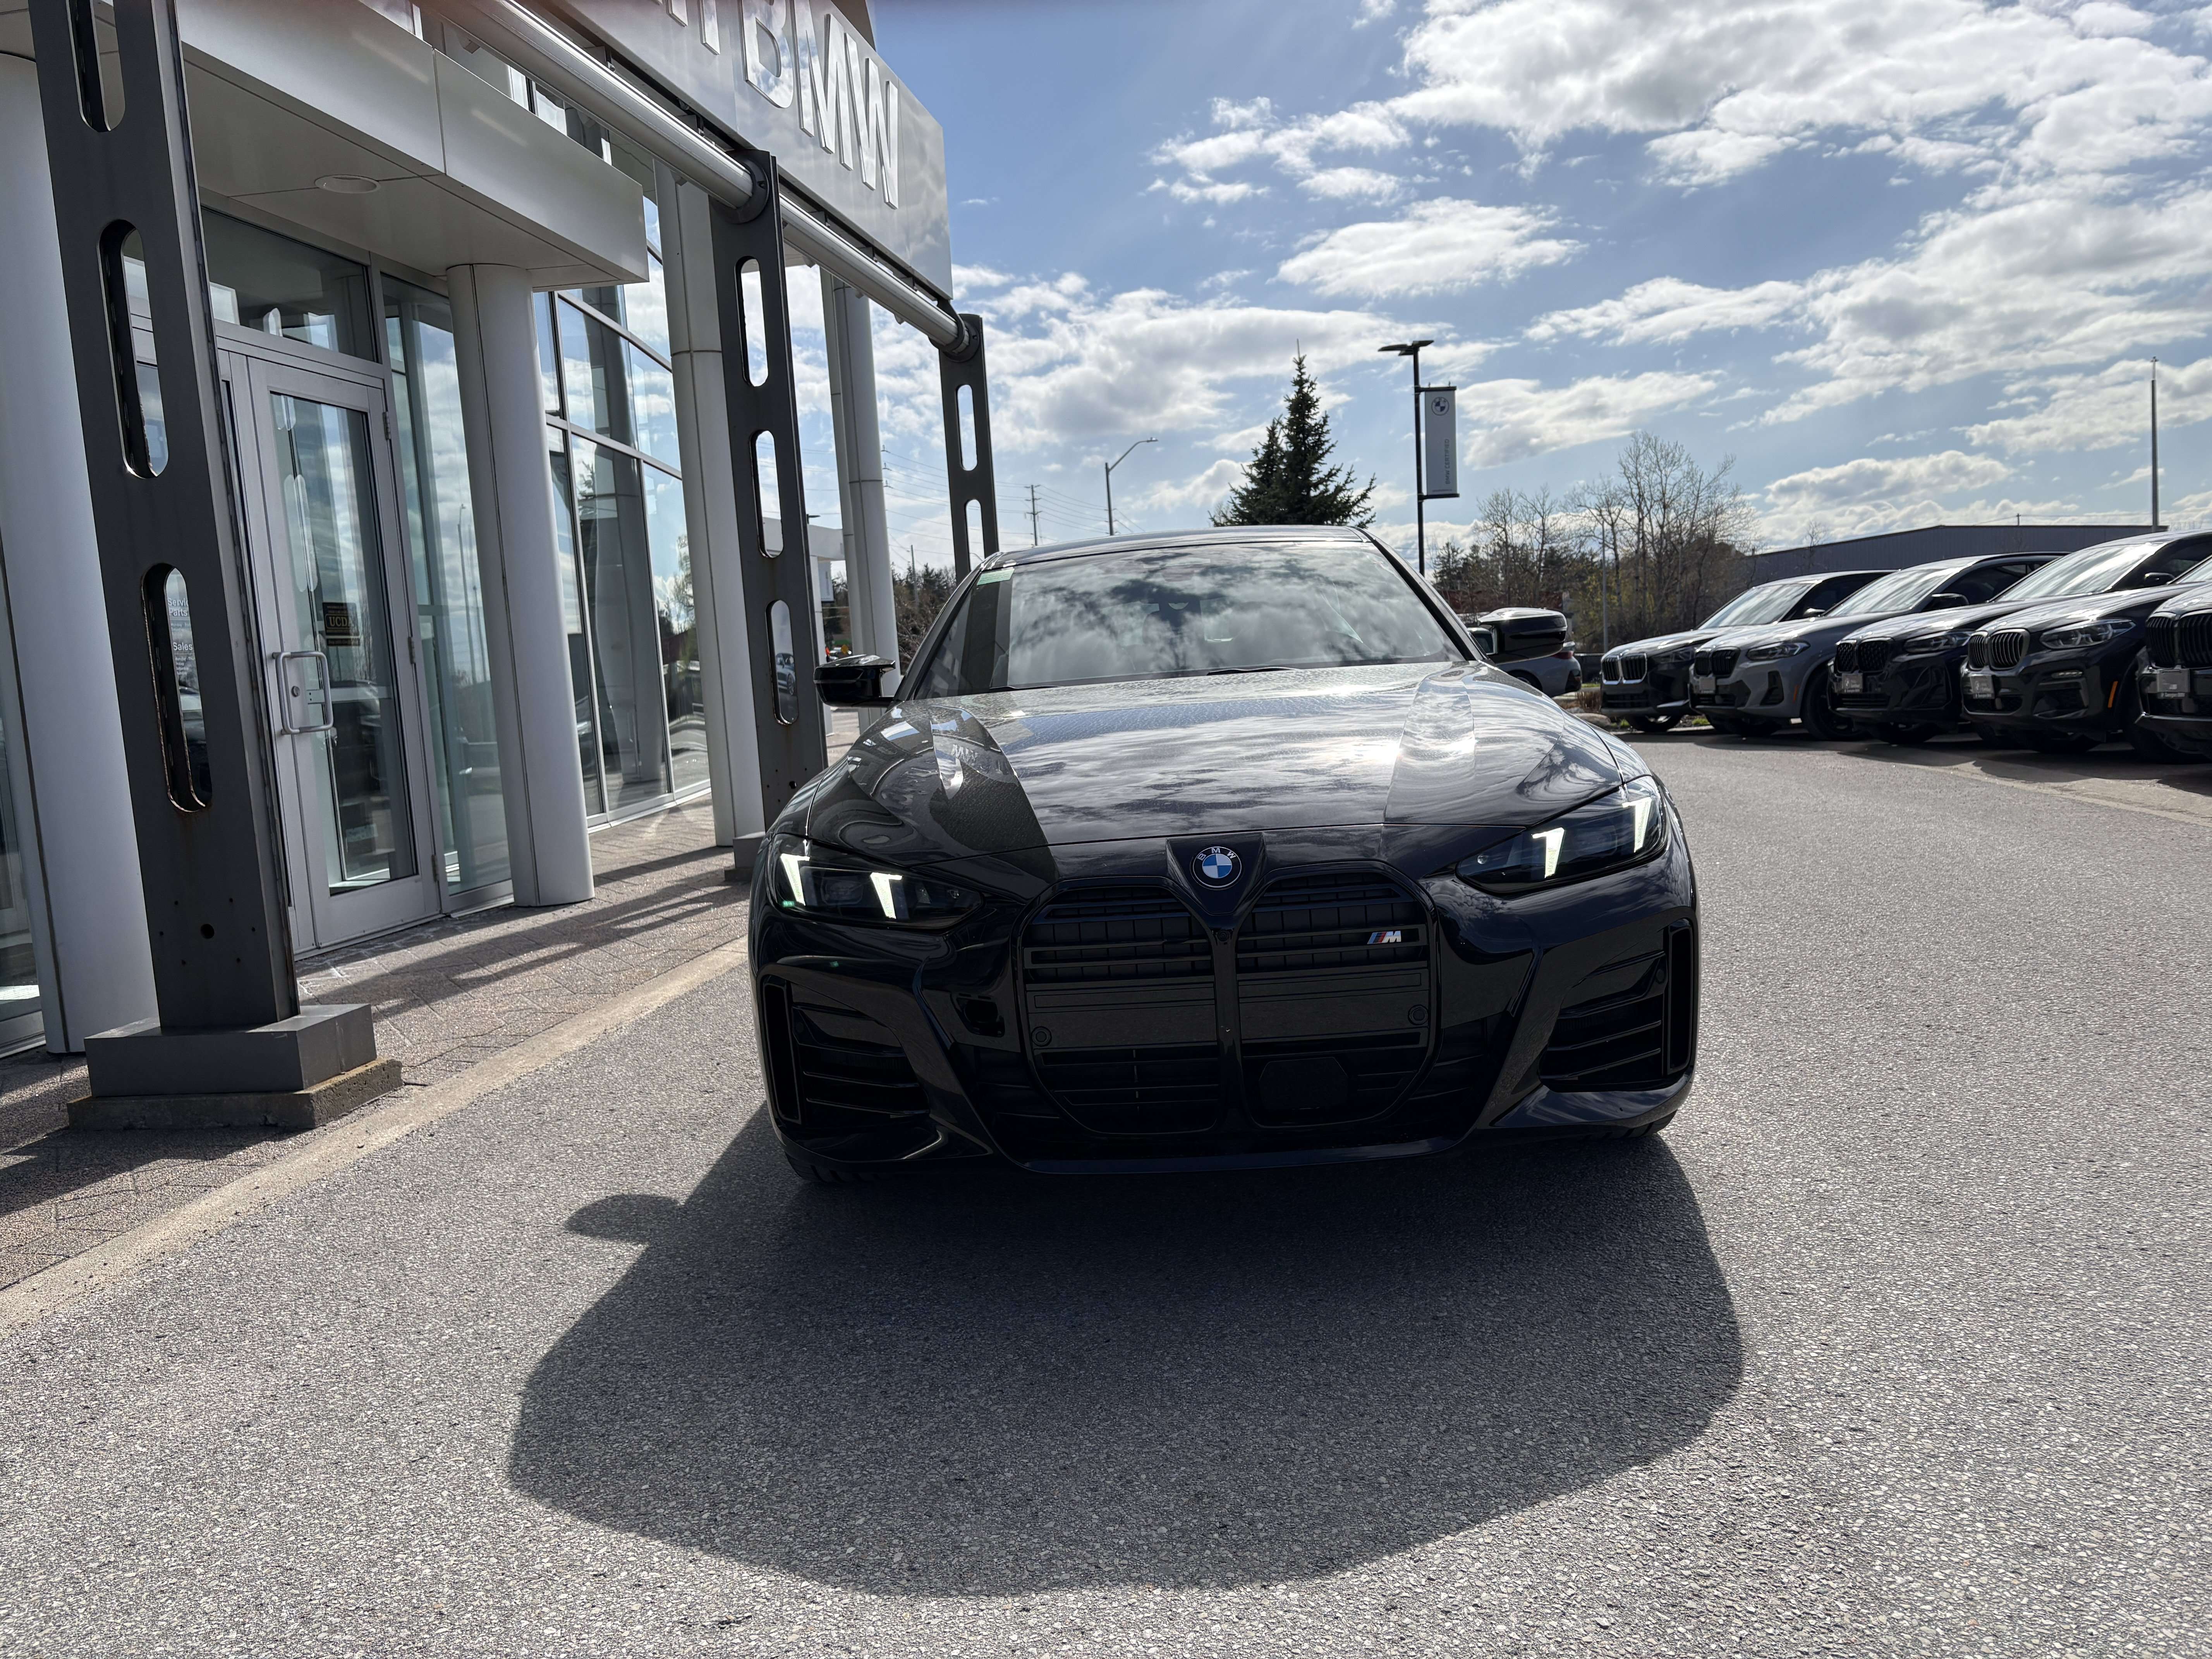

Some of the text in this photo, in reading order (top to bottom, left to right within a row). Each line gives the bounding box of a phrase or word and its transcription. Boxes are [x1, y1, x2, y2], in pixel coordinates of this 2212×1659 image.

[739, 0, 898, 210] BMW
[169, 607, 188, 617] Parts
[173, 642, 193, 651] Sales
[1197, 847, 1237, 861] BMW
